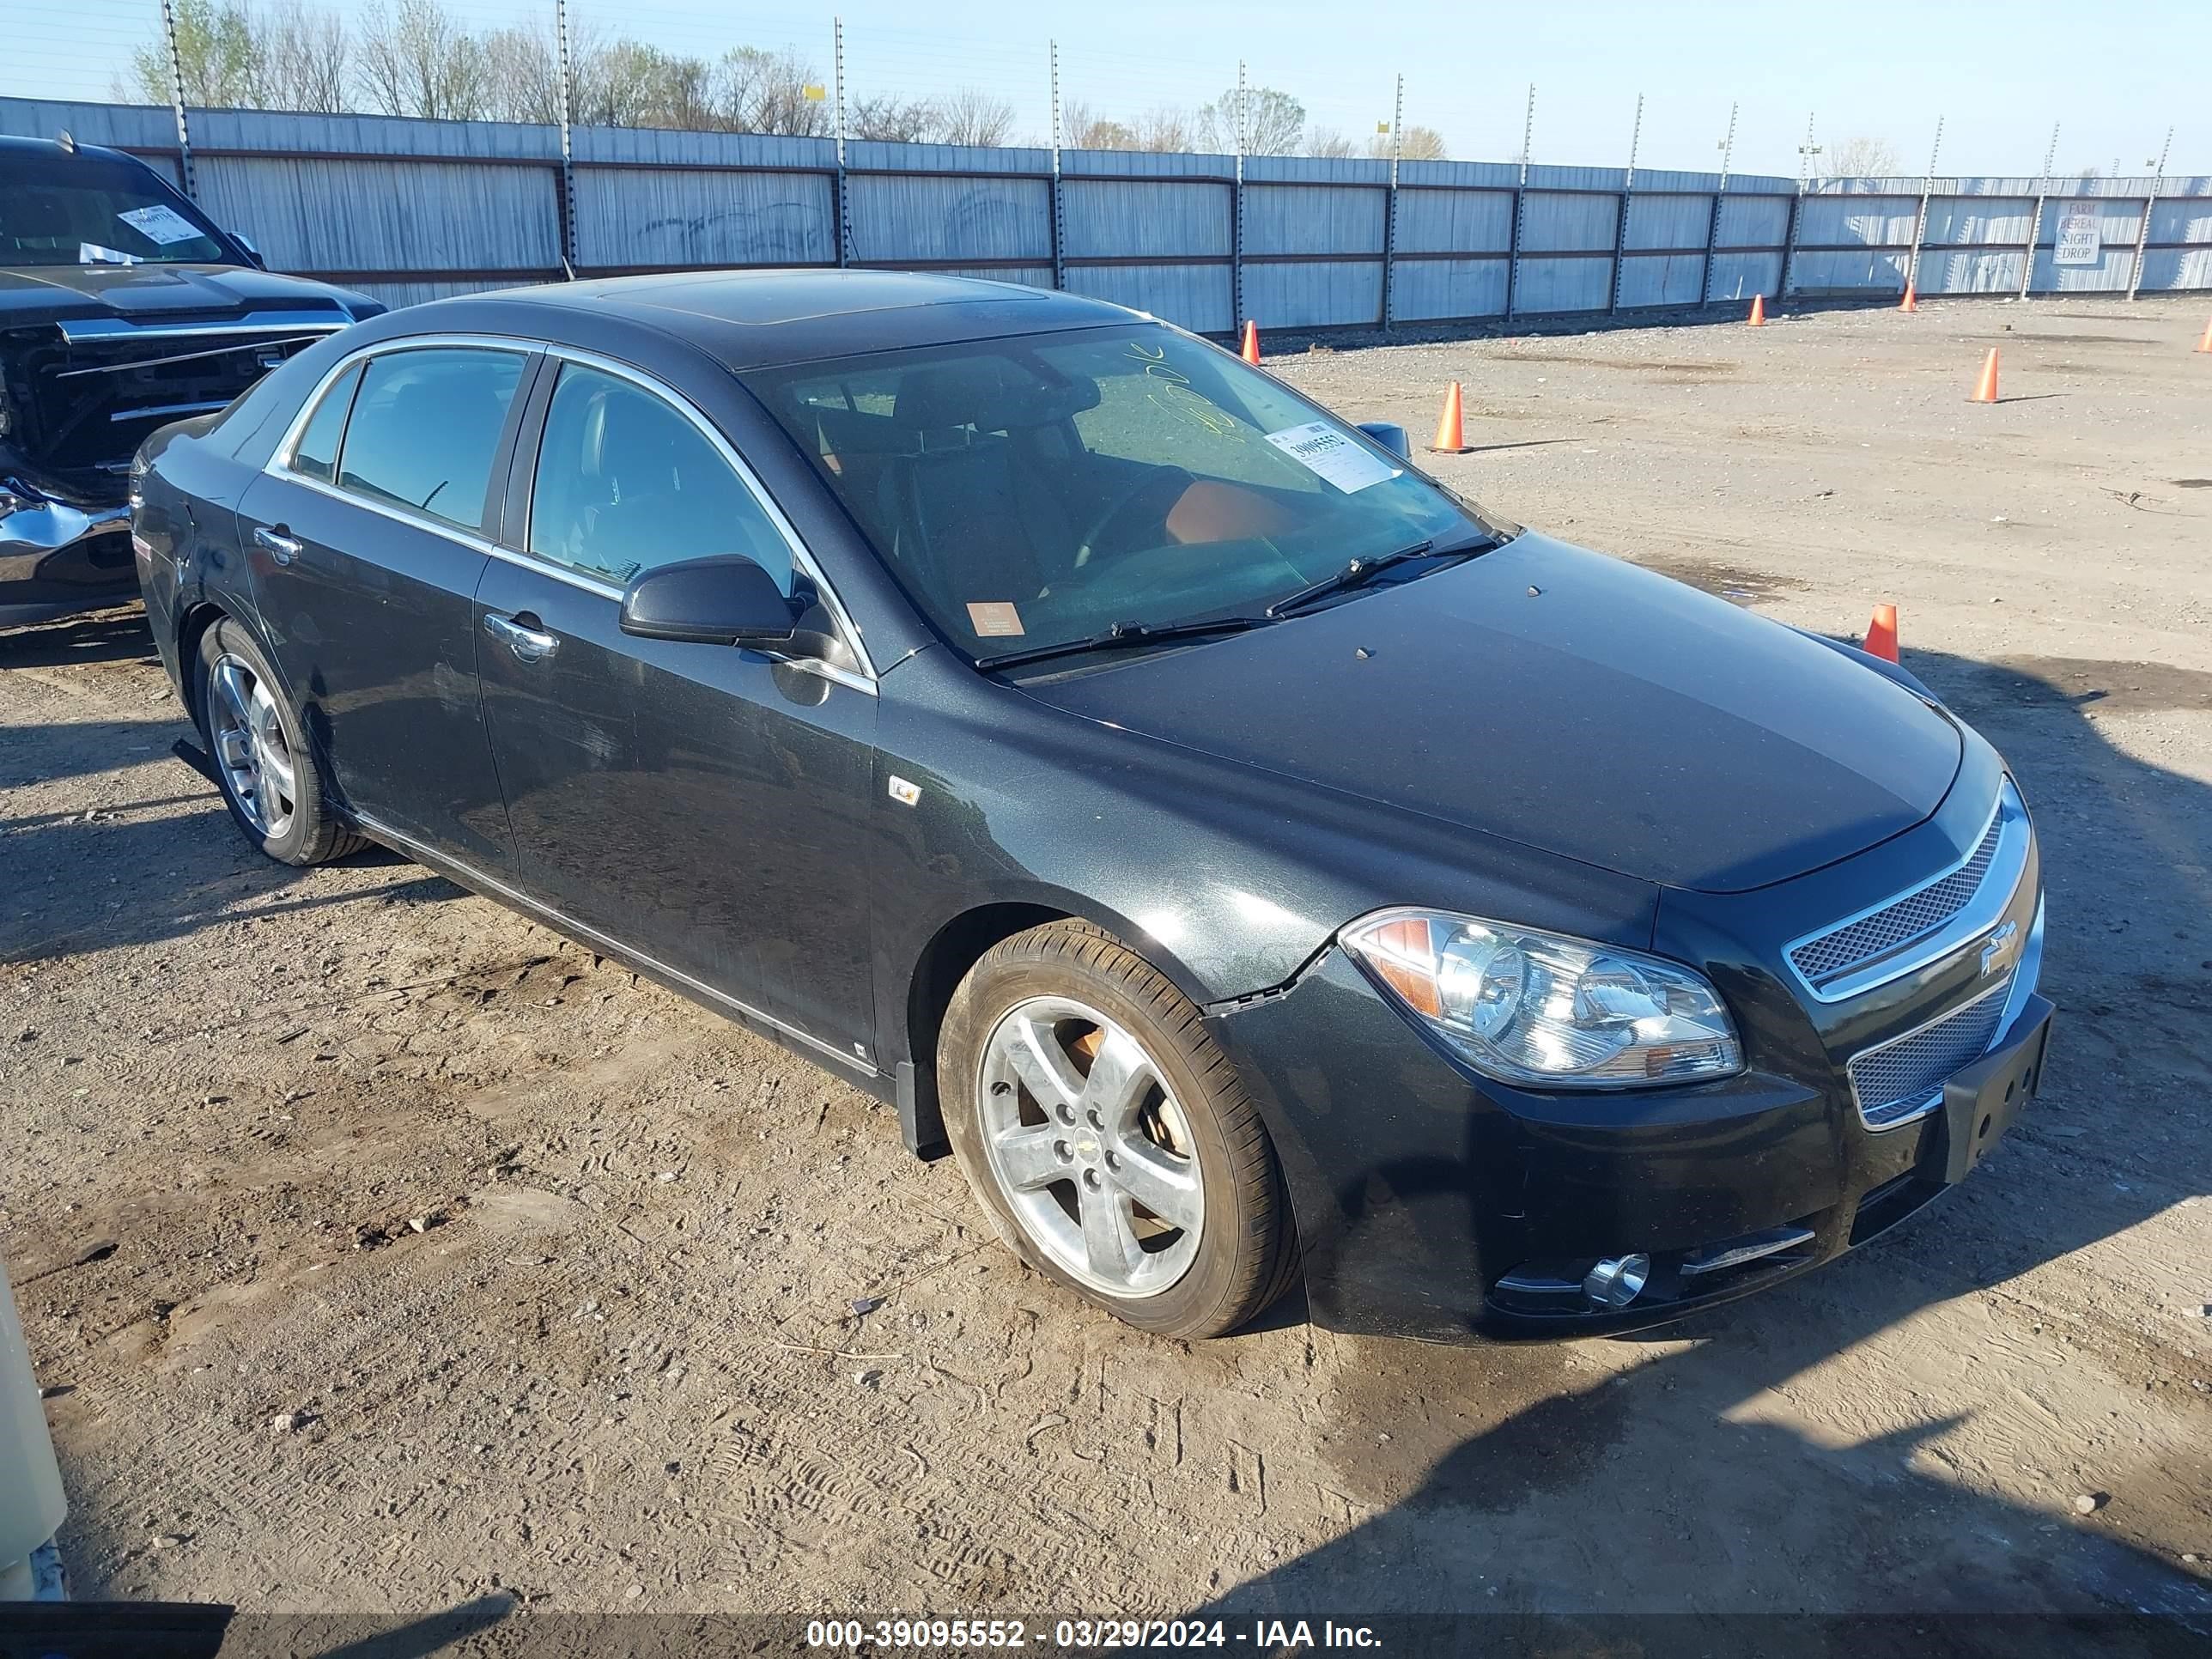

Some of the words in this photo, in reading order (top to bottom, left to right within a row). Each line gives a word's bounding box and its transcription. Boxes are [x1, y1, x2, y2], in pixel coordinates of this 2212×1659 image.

[2069, 203, 2096, 215] FARM
[2061, 233, 2095, 245] NIGHT
[2063, 247, 2092, 258] DROP
[1290, 434, 1346, 457] 39095552
